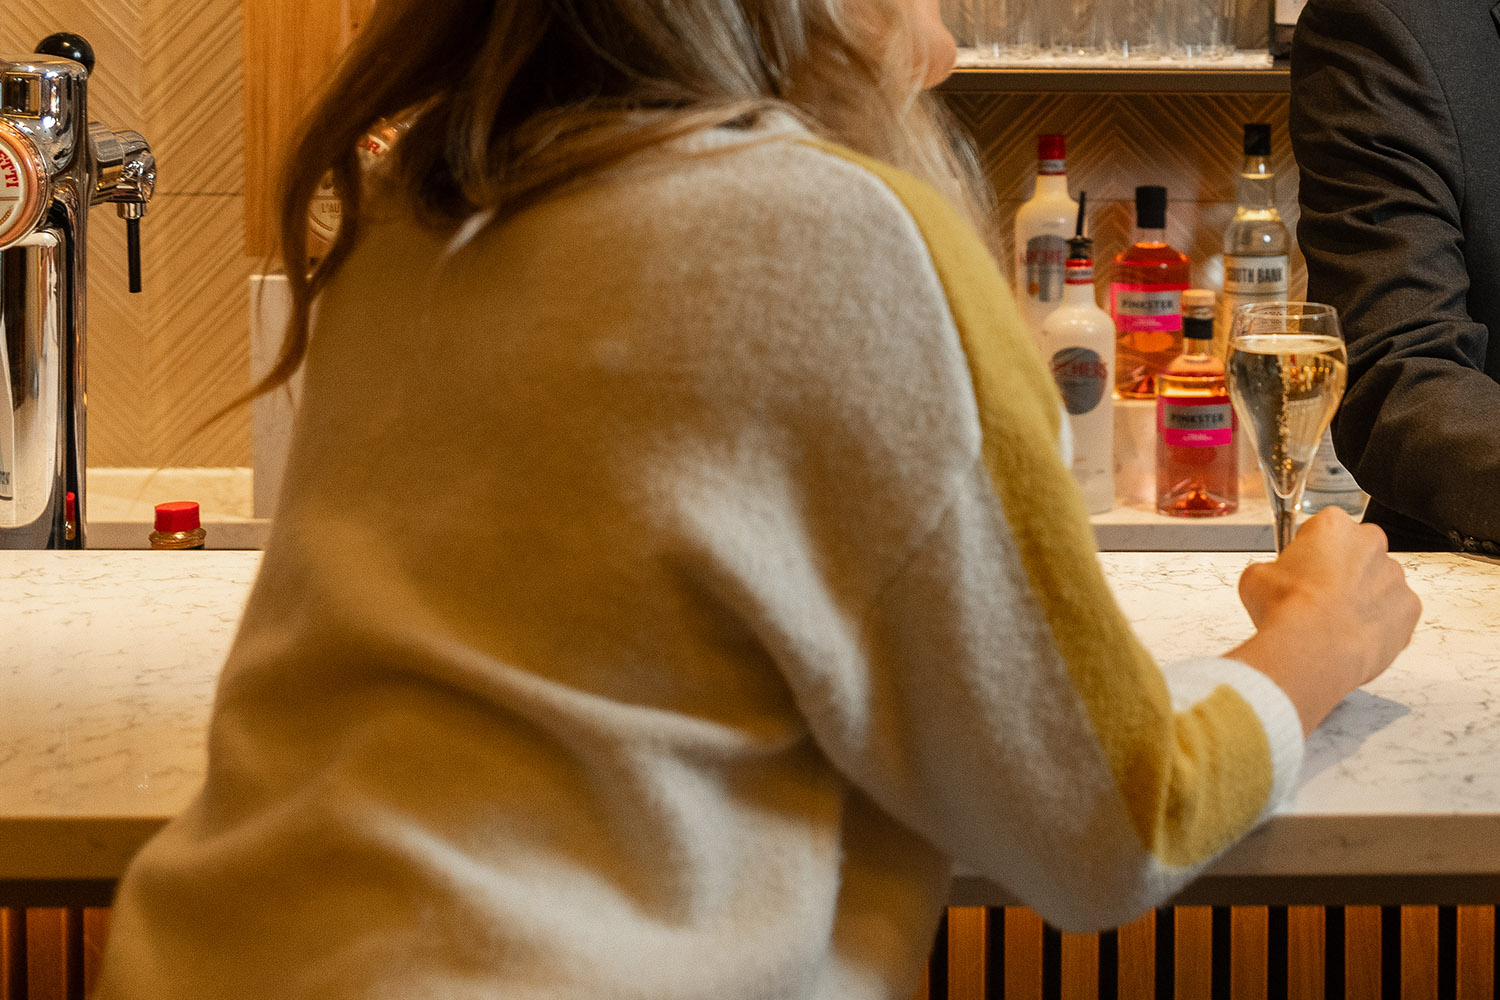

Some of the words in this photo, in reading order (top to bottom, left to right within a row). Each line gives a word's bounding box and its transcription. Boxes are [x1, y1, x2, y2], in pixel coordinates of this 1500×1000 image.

[0, 150, 20, 188] ETTI
[1227, 266, 1255, 284] SOUTH
[1257, 266, 1283, 284] BANK
[1121, 299, 1175, 311] PINKSTER
[1170, 412, 1225, 425] PINKSTER
